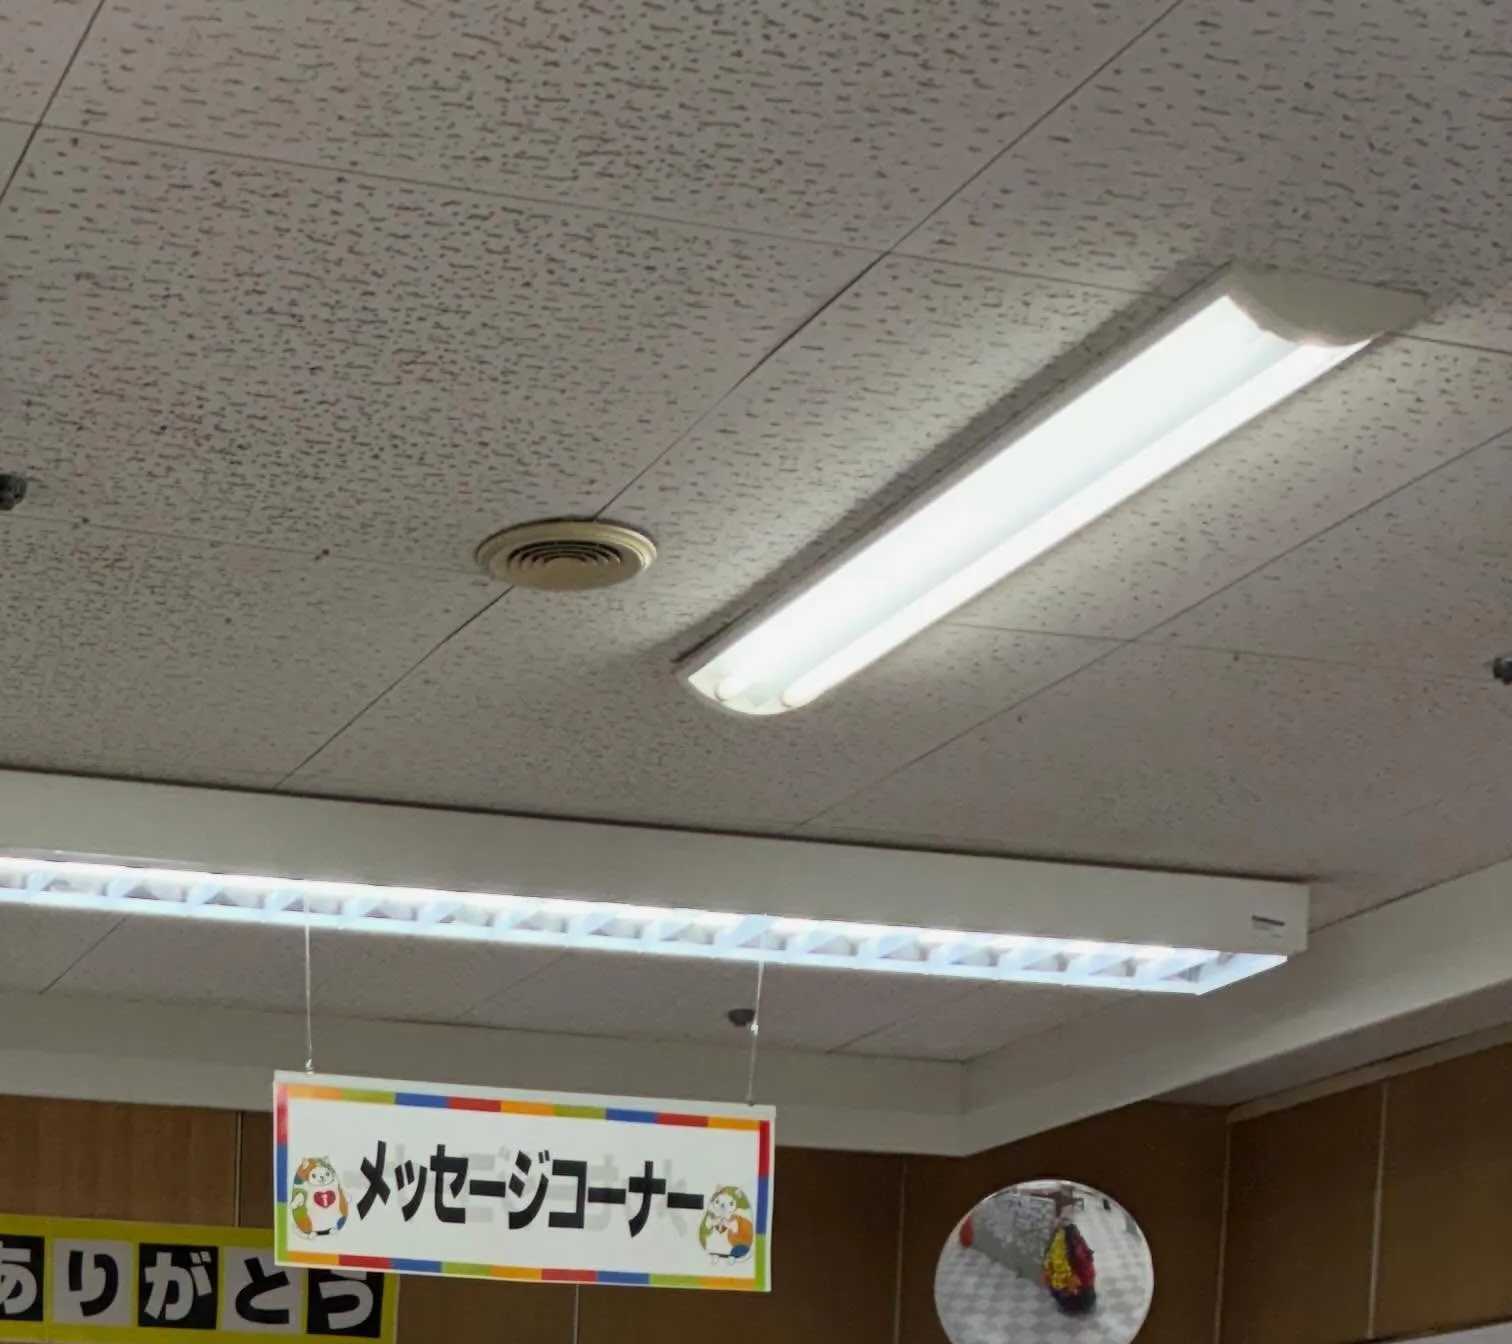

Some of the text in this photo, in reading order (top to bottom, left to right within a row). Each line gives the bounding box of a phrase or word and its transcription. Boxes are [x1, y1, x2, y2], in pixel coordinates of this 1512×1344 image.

[358, 1142, 703, 1236] メッセージコーナー
